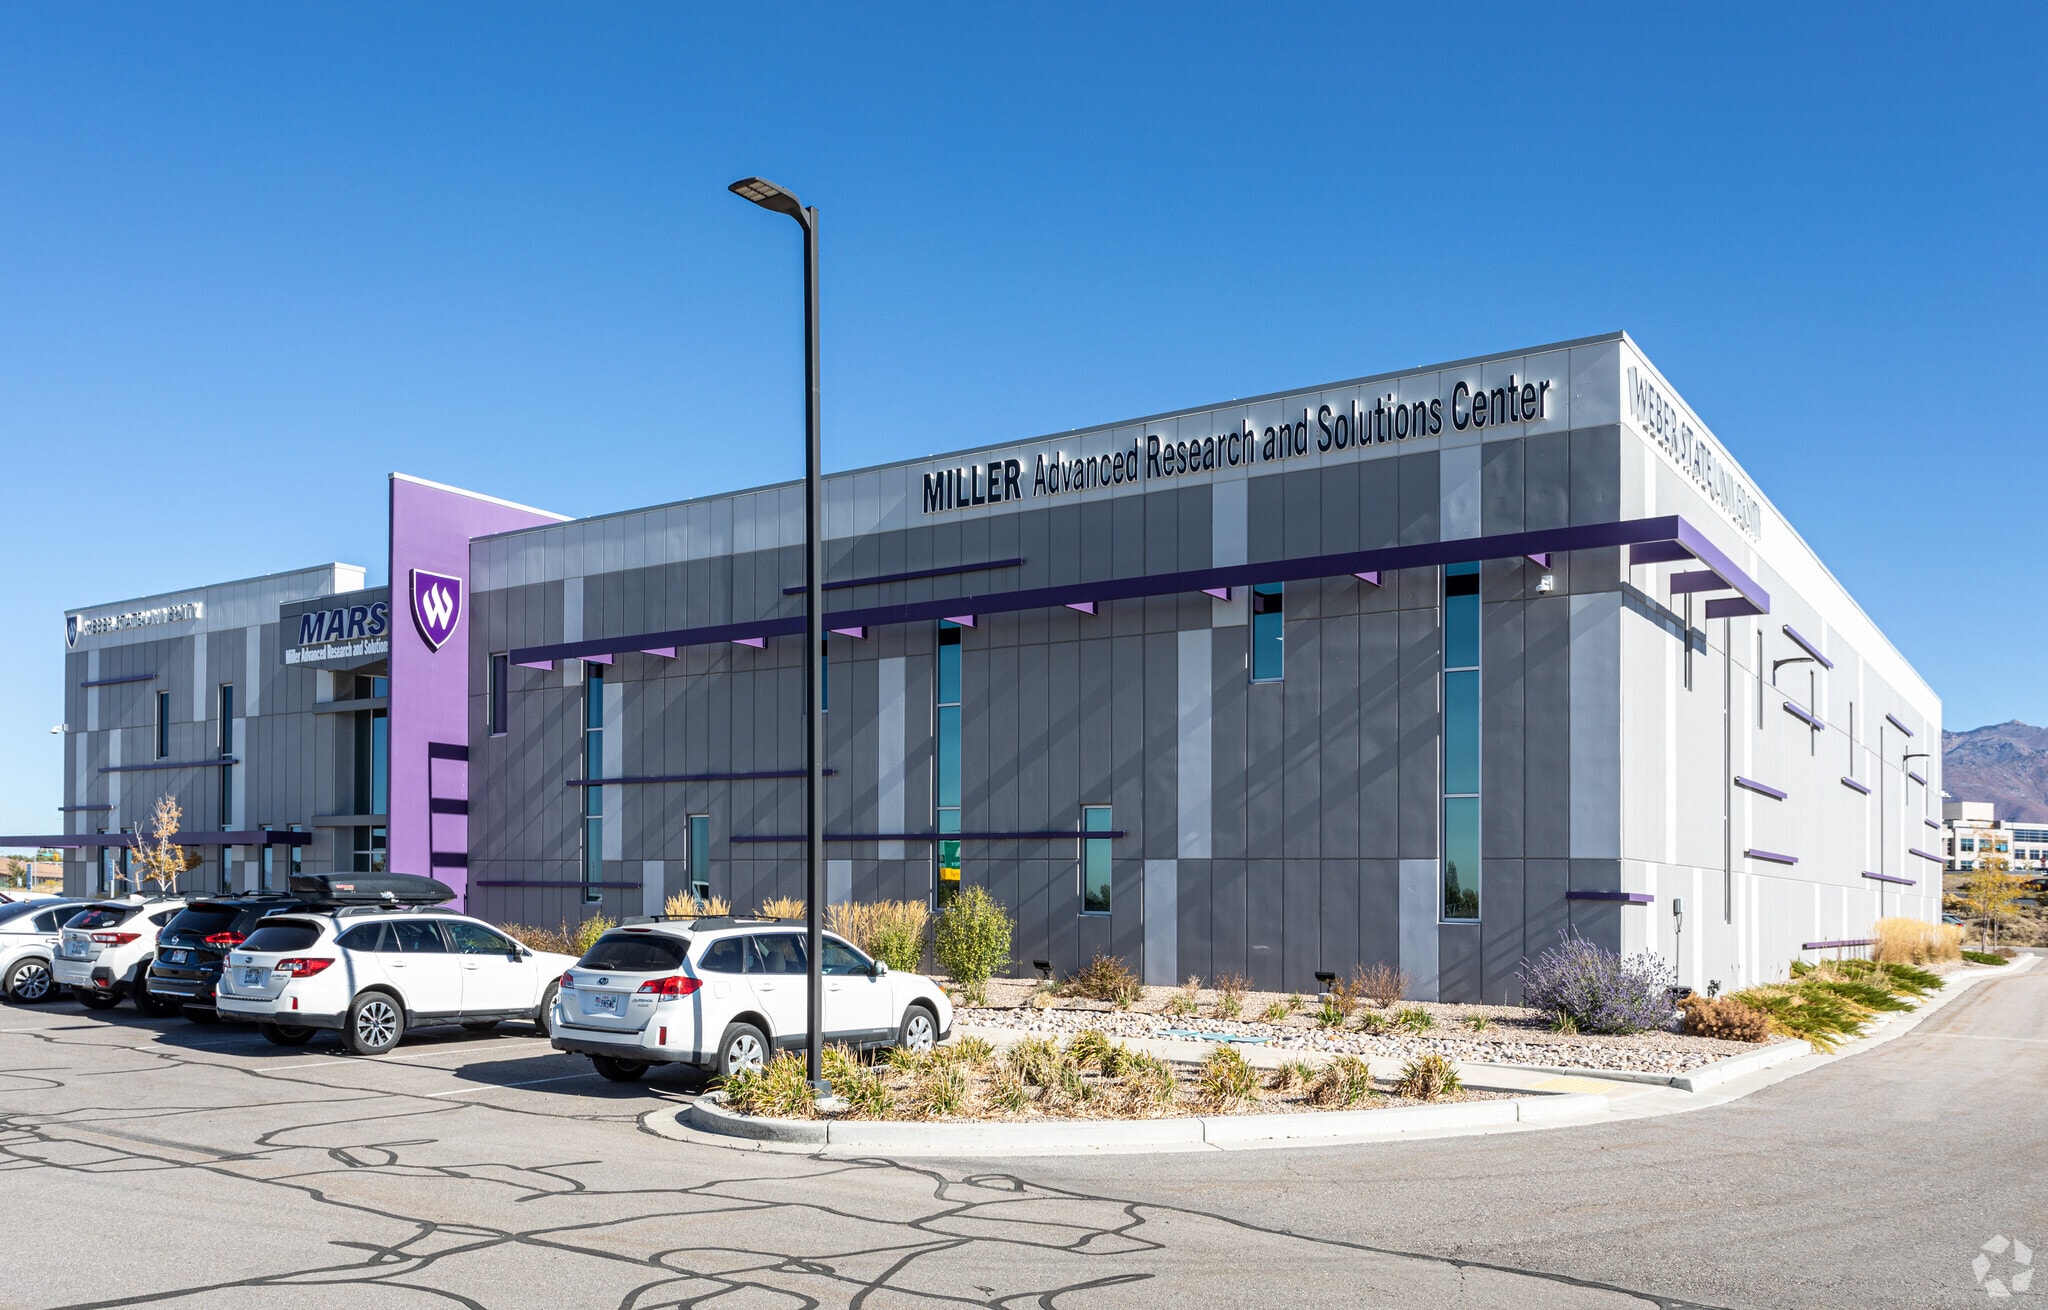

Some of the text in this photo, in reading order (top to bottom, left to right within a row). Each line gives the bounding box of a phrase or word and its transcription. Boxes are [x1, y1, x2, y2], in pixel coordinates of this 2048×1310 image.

[922, 374, 1552, 514] MILLER Advanced Research and Solutions Center
[1627, 365, 1679, 457] WEBER
[1680, 421, 1713, 488] STATE
[298, 602, 388, 646] MARS
[422, 582, 453, 631] W
[301, 644, 327, 662] Advanced
[327, 641, 353, 659] Research
[353, 640, 364, 656] and
